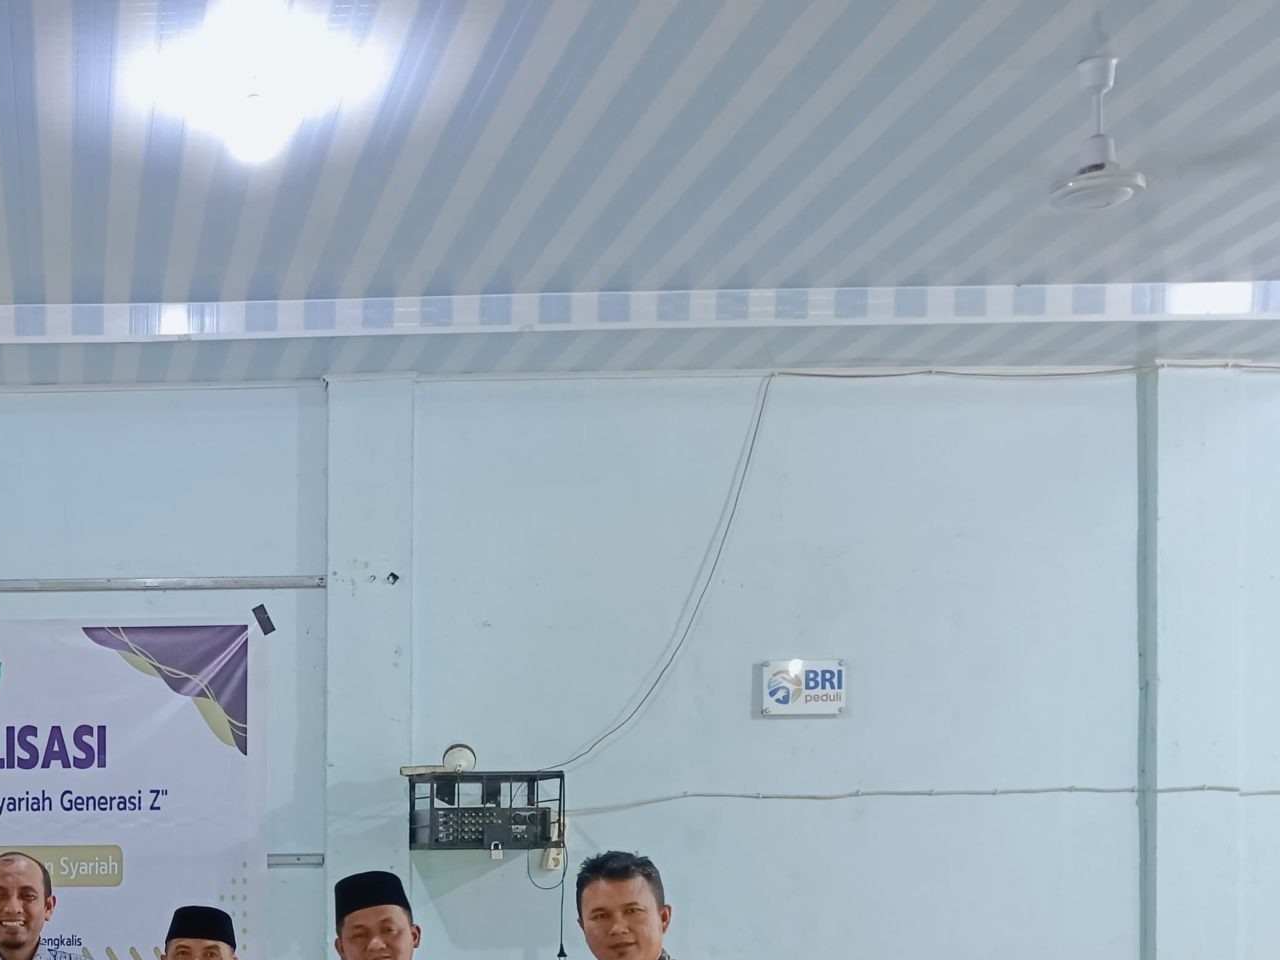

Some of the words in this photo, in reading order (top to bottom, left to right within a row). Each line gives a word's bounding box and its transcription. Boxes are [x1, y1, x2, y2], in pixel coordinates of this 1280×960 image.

[804, 669, 843, 690] BRI
[804, 692, 842, 704] peduli
[60, 789, 142, 812] Generasi
[149, 788, 168, 811] Z"
[60, 855, 119, 879] Syariah
